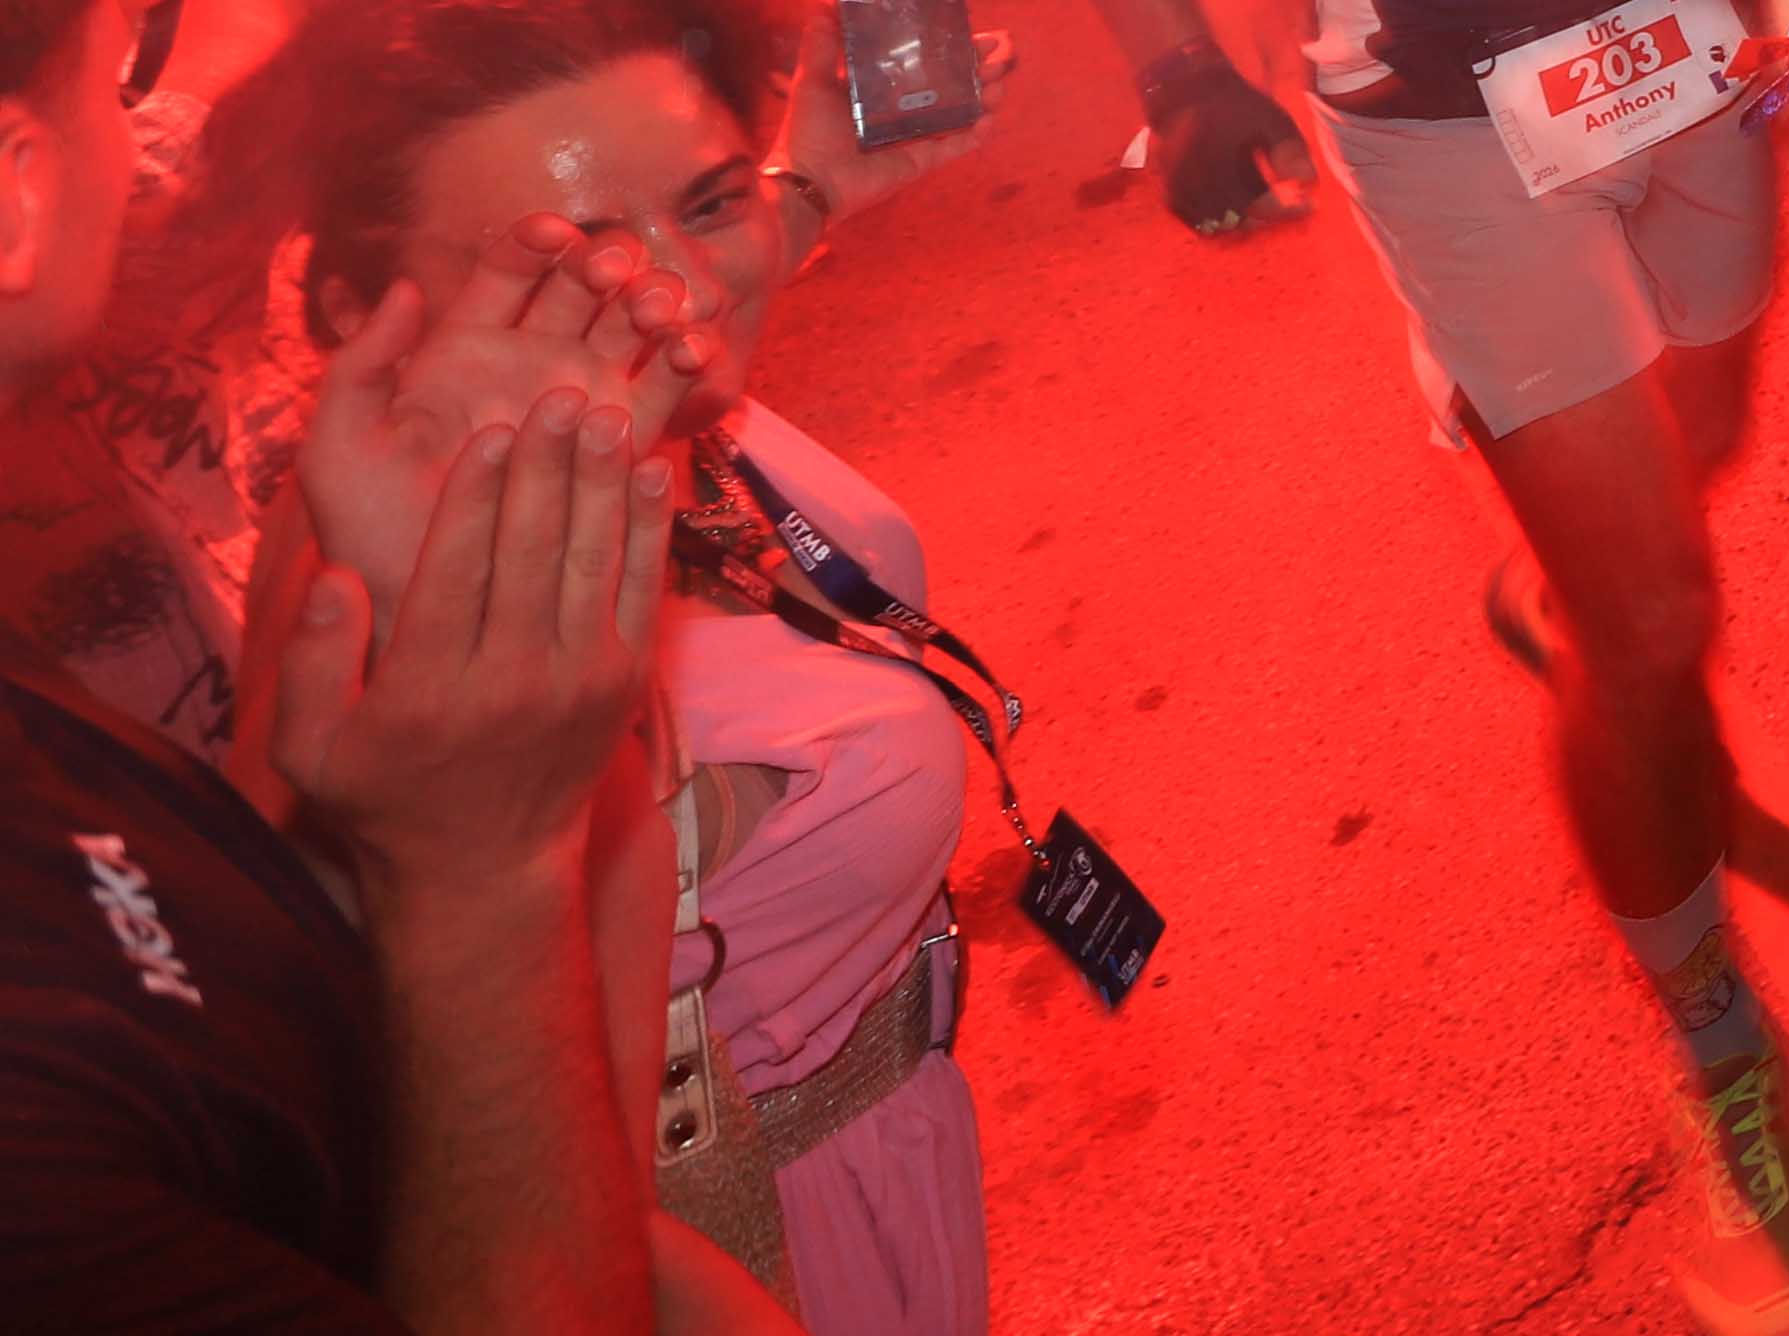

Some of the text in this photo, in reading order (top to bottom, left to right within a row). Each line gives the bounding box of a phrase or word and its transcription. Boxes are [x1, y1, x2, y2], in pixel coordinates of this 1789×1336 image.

[1587, 15, 1625, 46] UTC
[1568, 31, 1661, 104] 203
[1585, 81, 1676, 133] Anthony
[784, 509, 833, 564] UTMB
